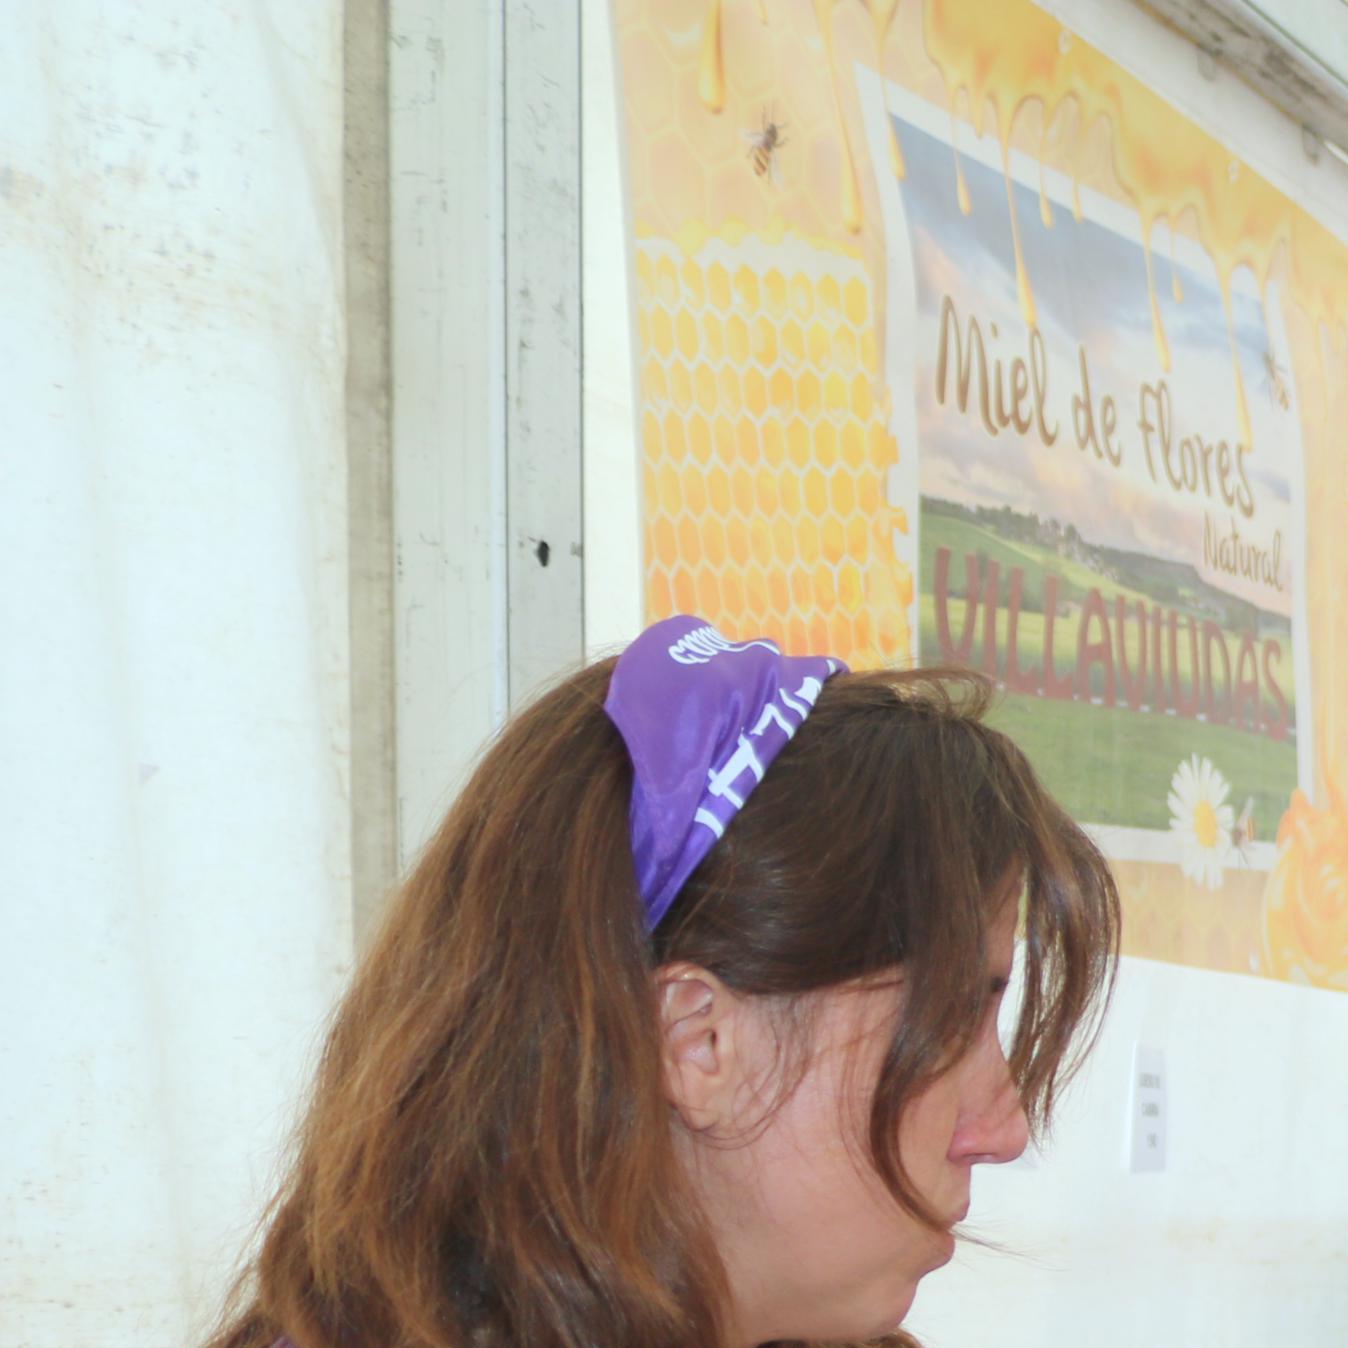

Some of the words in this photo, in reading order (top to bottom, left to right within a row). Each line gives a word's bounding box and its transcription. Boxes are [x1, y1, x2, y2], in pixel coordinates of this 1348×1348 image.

[935, 294, 1058, 447] Miel
[1071, 343, 1122, 467] de
[1203, 511, 1284, 592] Natural
